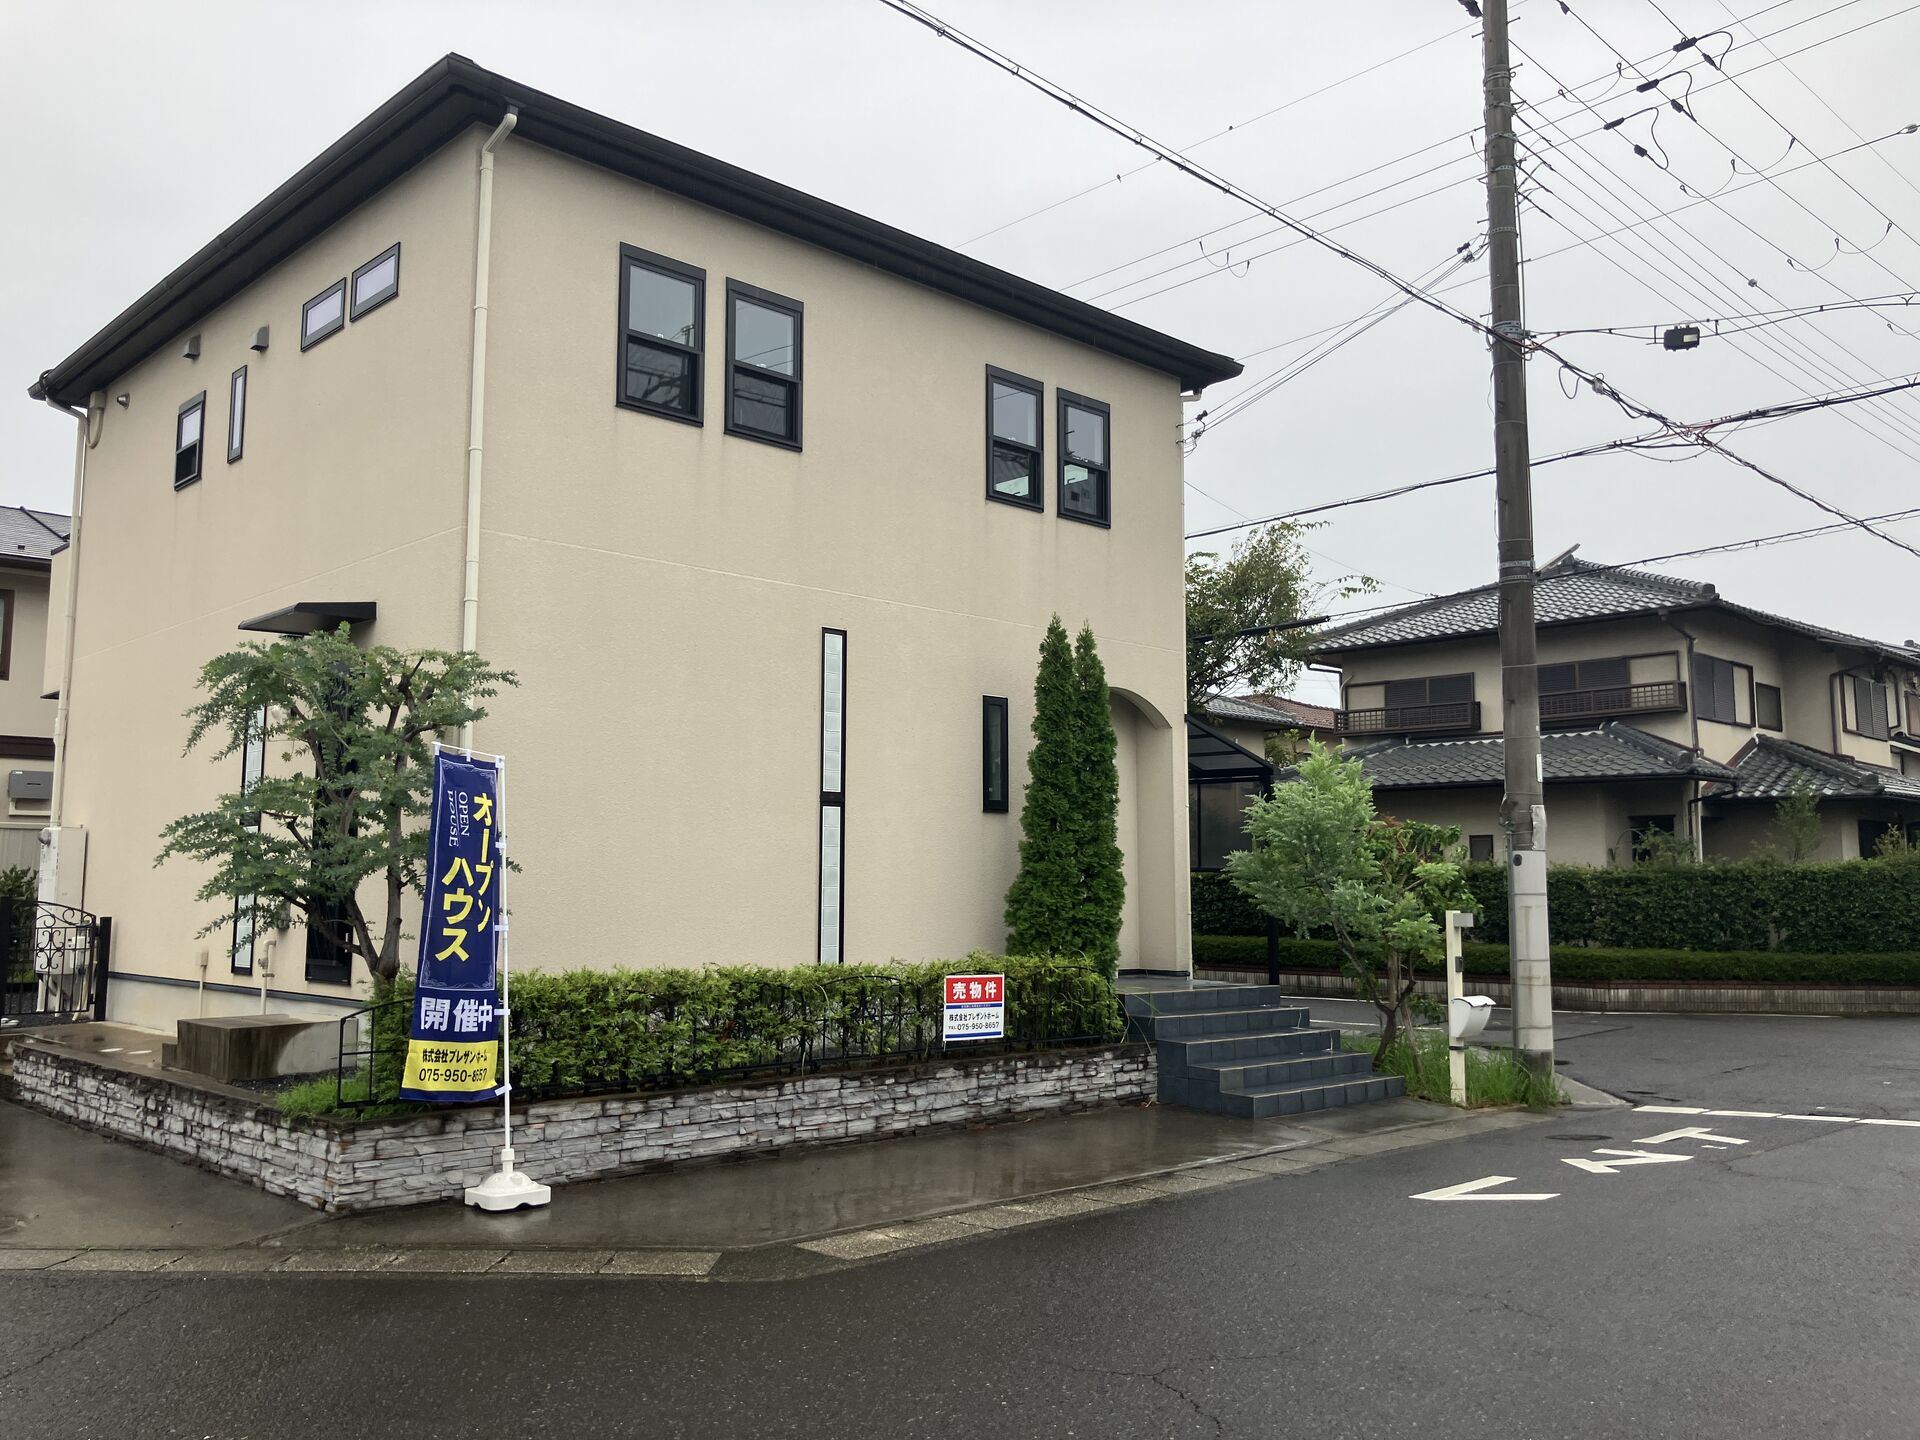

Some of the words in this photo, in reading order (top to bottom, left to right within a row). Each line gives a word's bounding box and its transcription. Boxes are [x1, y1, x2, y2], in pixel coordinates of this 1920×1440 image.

[447, 790, 459, 847] HOUSE
[458, 791, 470, 837] OPEN
[473, 793, 494, 932] オープン
[434, 857, 475, 962] ハウス
[953, 981, 996, 999] 売物件
[420, 997, 493, 1032] 開催中
[957, 1022, 999, 1030] 075-950-8657
